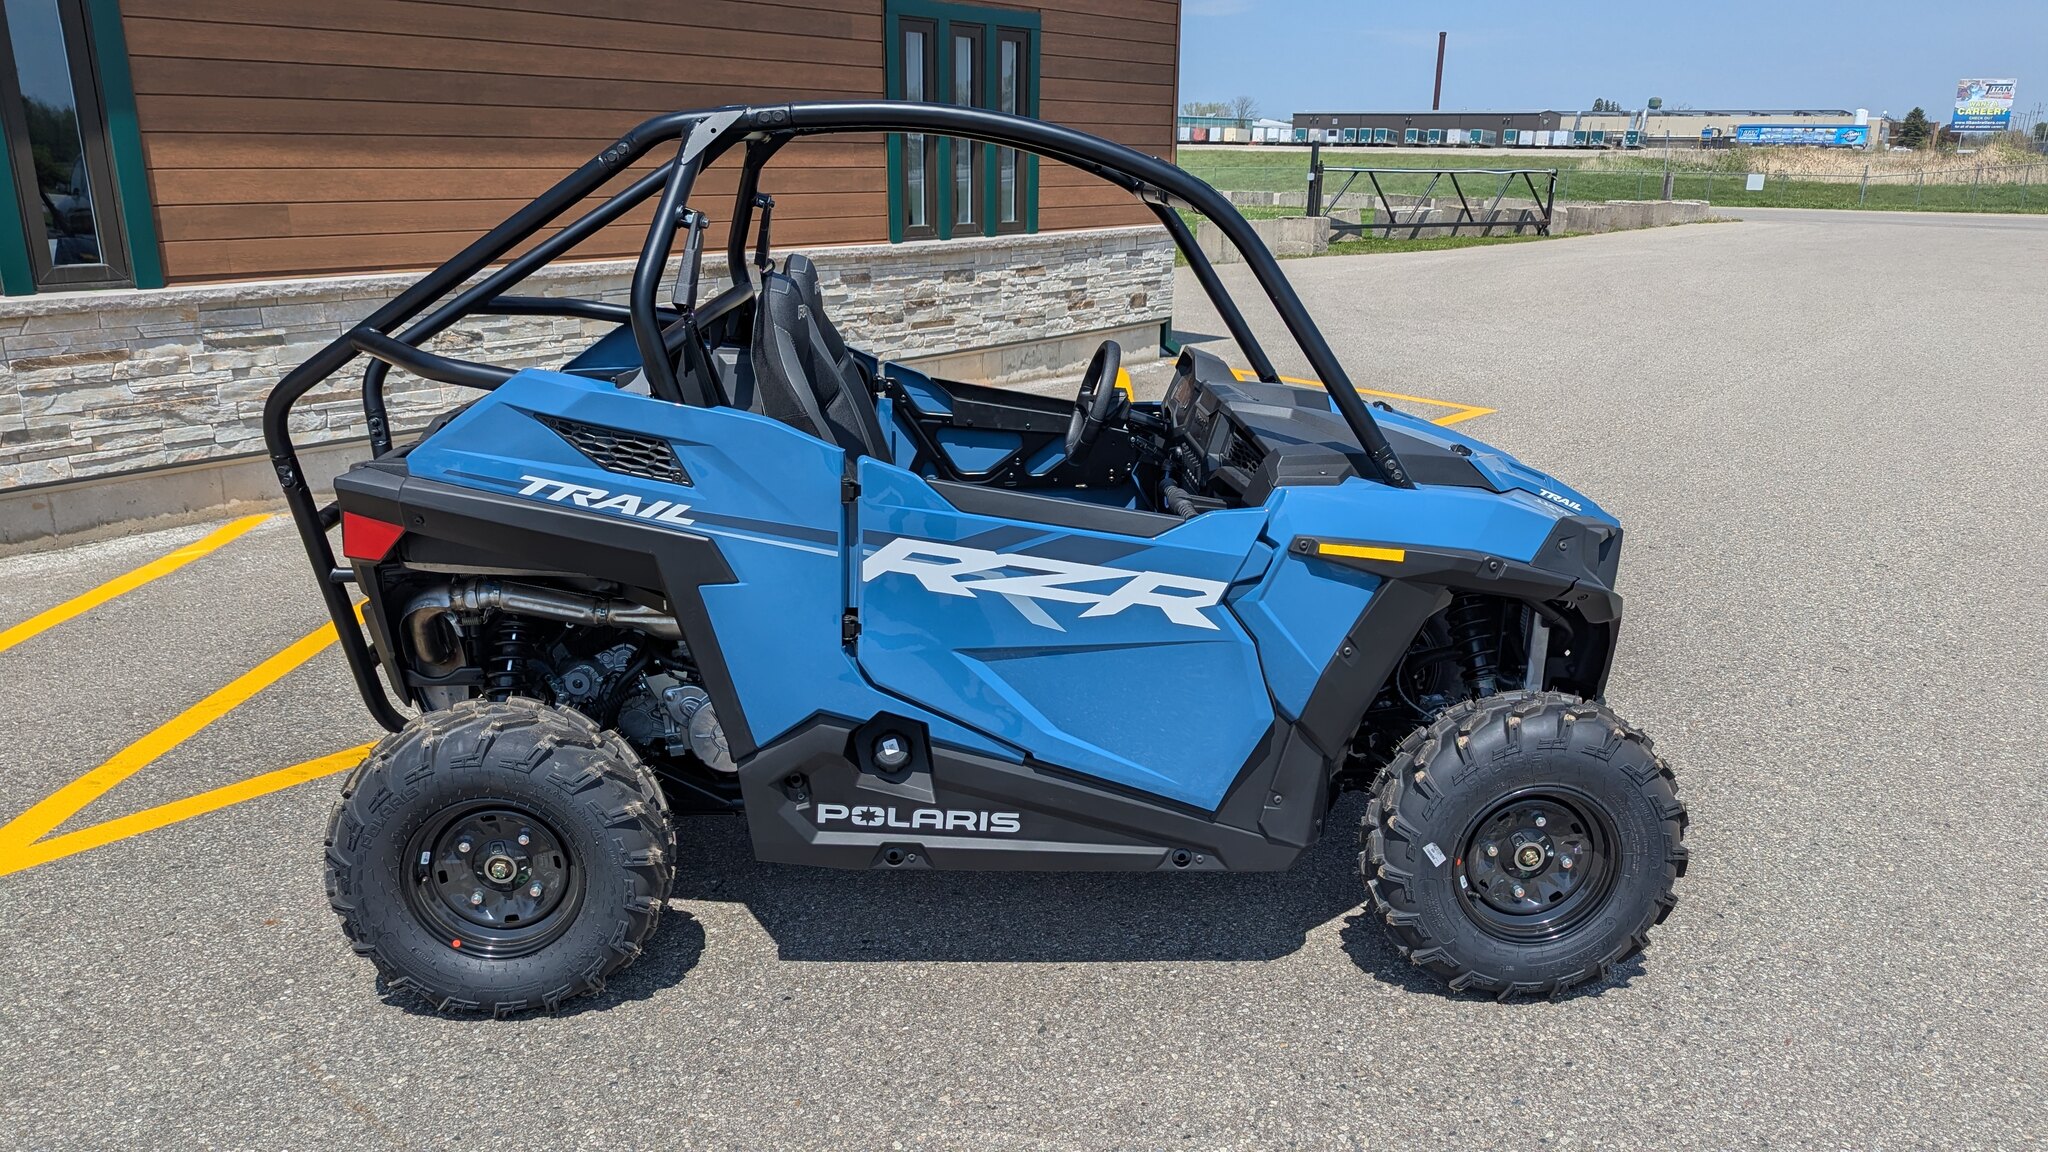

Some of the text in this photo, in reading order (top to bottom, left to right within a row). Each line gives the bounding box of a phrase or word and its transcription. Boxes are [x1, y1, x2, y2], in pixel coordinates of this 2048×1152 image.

[1985, 84, 2013, 95] TITAN
[1957, 107, 2007, 115] CAREER?
[518, 475, 695, 525] TRAIL
[1540, 488, 1582, 511] TRAIL
[862, 537, 1229, 631] RZR
[817, 803, 1021, 833] POLARIS
